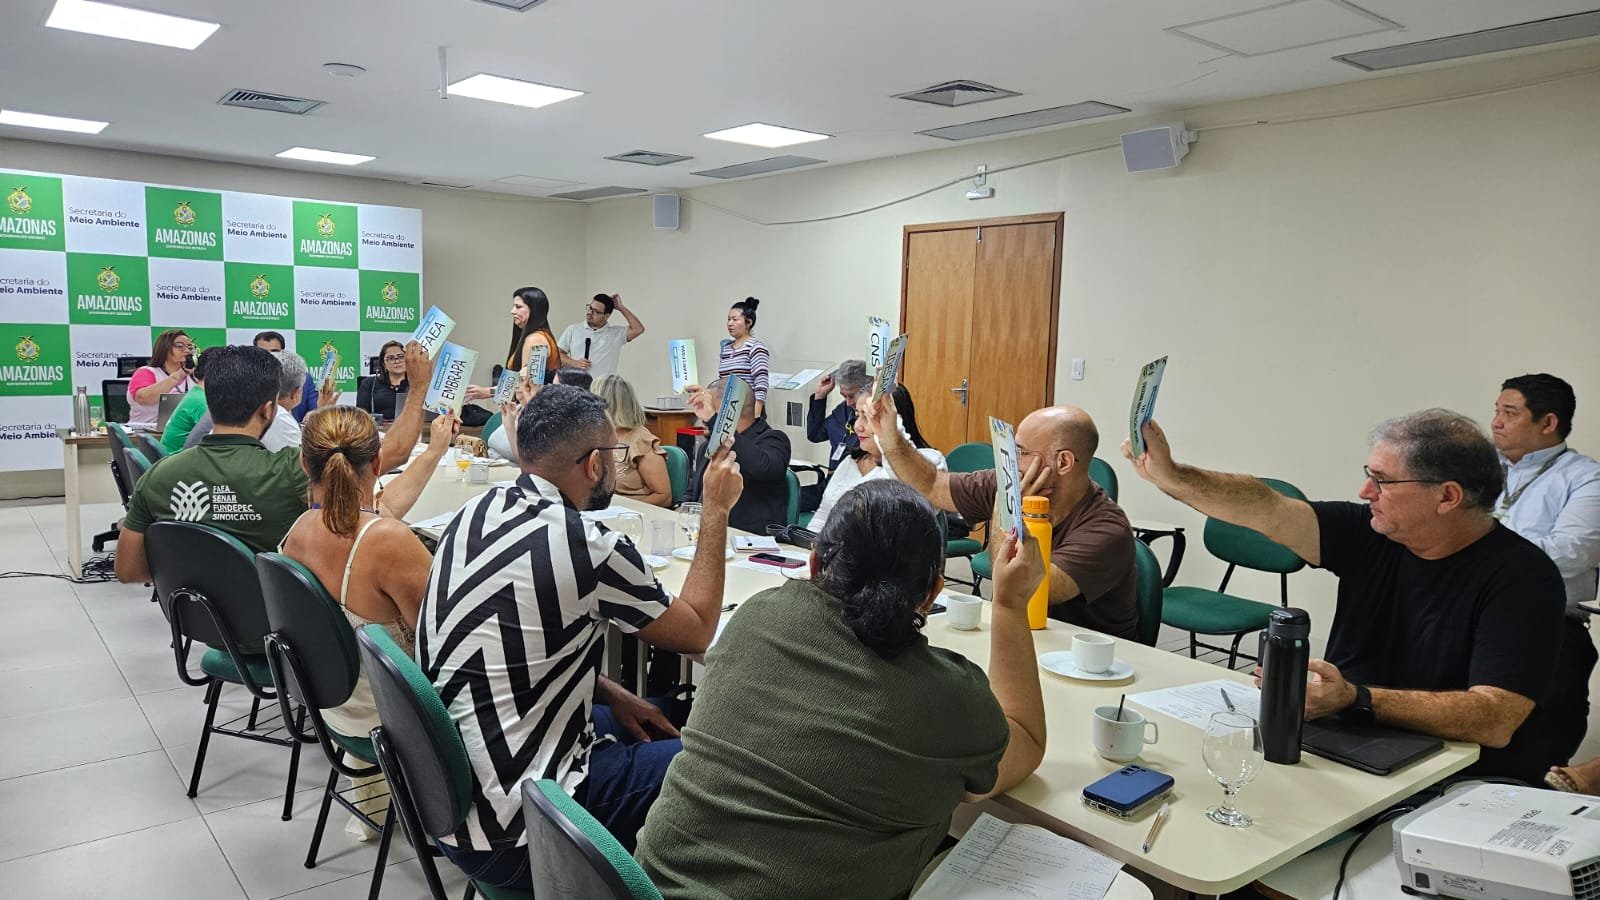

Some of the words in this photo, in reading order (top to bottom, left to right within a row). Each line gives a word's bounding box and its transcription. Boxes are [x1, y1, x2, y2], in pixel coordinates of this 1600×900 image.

[69, 206, 112, 218] Secretaria
[114, 210, 127, 219] do
[70, 215, 93, 225] Meio
[95, 218, 140, 228] Ambiente
[226, 220, 265, 230] Secretaria
[266, 223, 276, 231] do
[154, 228, 217, 247] AMAZONAS
[227, 228, 248, 237] Meio
[250, 229, 288, 239] Ambiente
[361, 231, 395, 241] Secretaria
[396, 232, 405, 241] do
[300, 239, 353, 256] AMAZONAS
[361, 239, 379, 247] Meio
[381, 240, 415, 249] Ambiente
[36, 278, 50, 286] do
[17, 286, 63, 295] Ambiente
[156, 283, 196, 293] Secretaria
[198, 285, 210, 294] do
[156, 292, 179, 300] Meio
[181, 293, 222, 302] Ambiente
[300, 290, 335, 298] Secretaria
[337, 291, 347, 299] do
[77, 294, 143, 312] AMAZONAS
[321, 298, 357, 307] Ambiente
[232, 300, 289, 317] AMAZONAS
[366, 305, 415, 320] AMAZONAS
[421, 321, 446, 352] FAEA
[76, 351, 119, 359] Secretaria
[870, 332, 881, 368] CNS
[530, 354, 541, 379] FACEA
[441, 359, 467, 400] EMBRAPA
[720, 399, 739, 445] CREA
[0, 432, 22, 440] Meio
[24, 431, 58, 439] Ambie
[1000, 447, 1017, 515] FAS
[212, 485, 231, 493] FAEA
[212, 494, 238, 503] SENAR
[213, 504, 253, 512] FUNDEPEC
[212, 513, 262, 521] SINDICATOS
